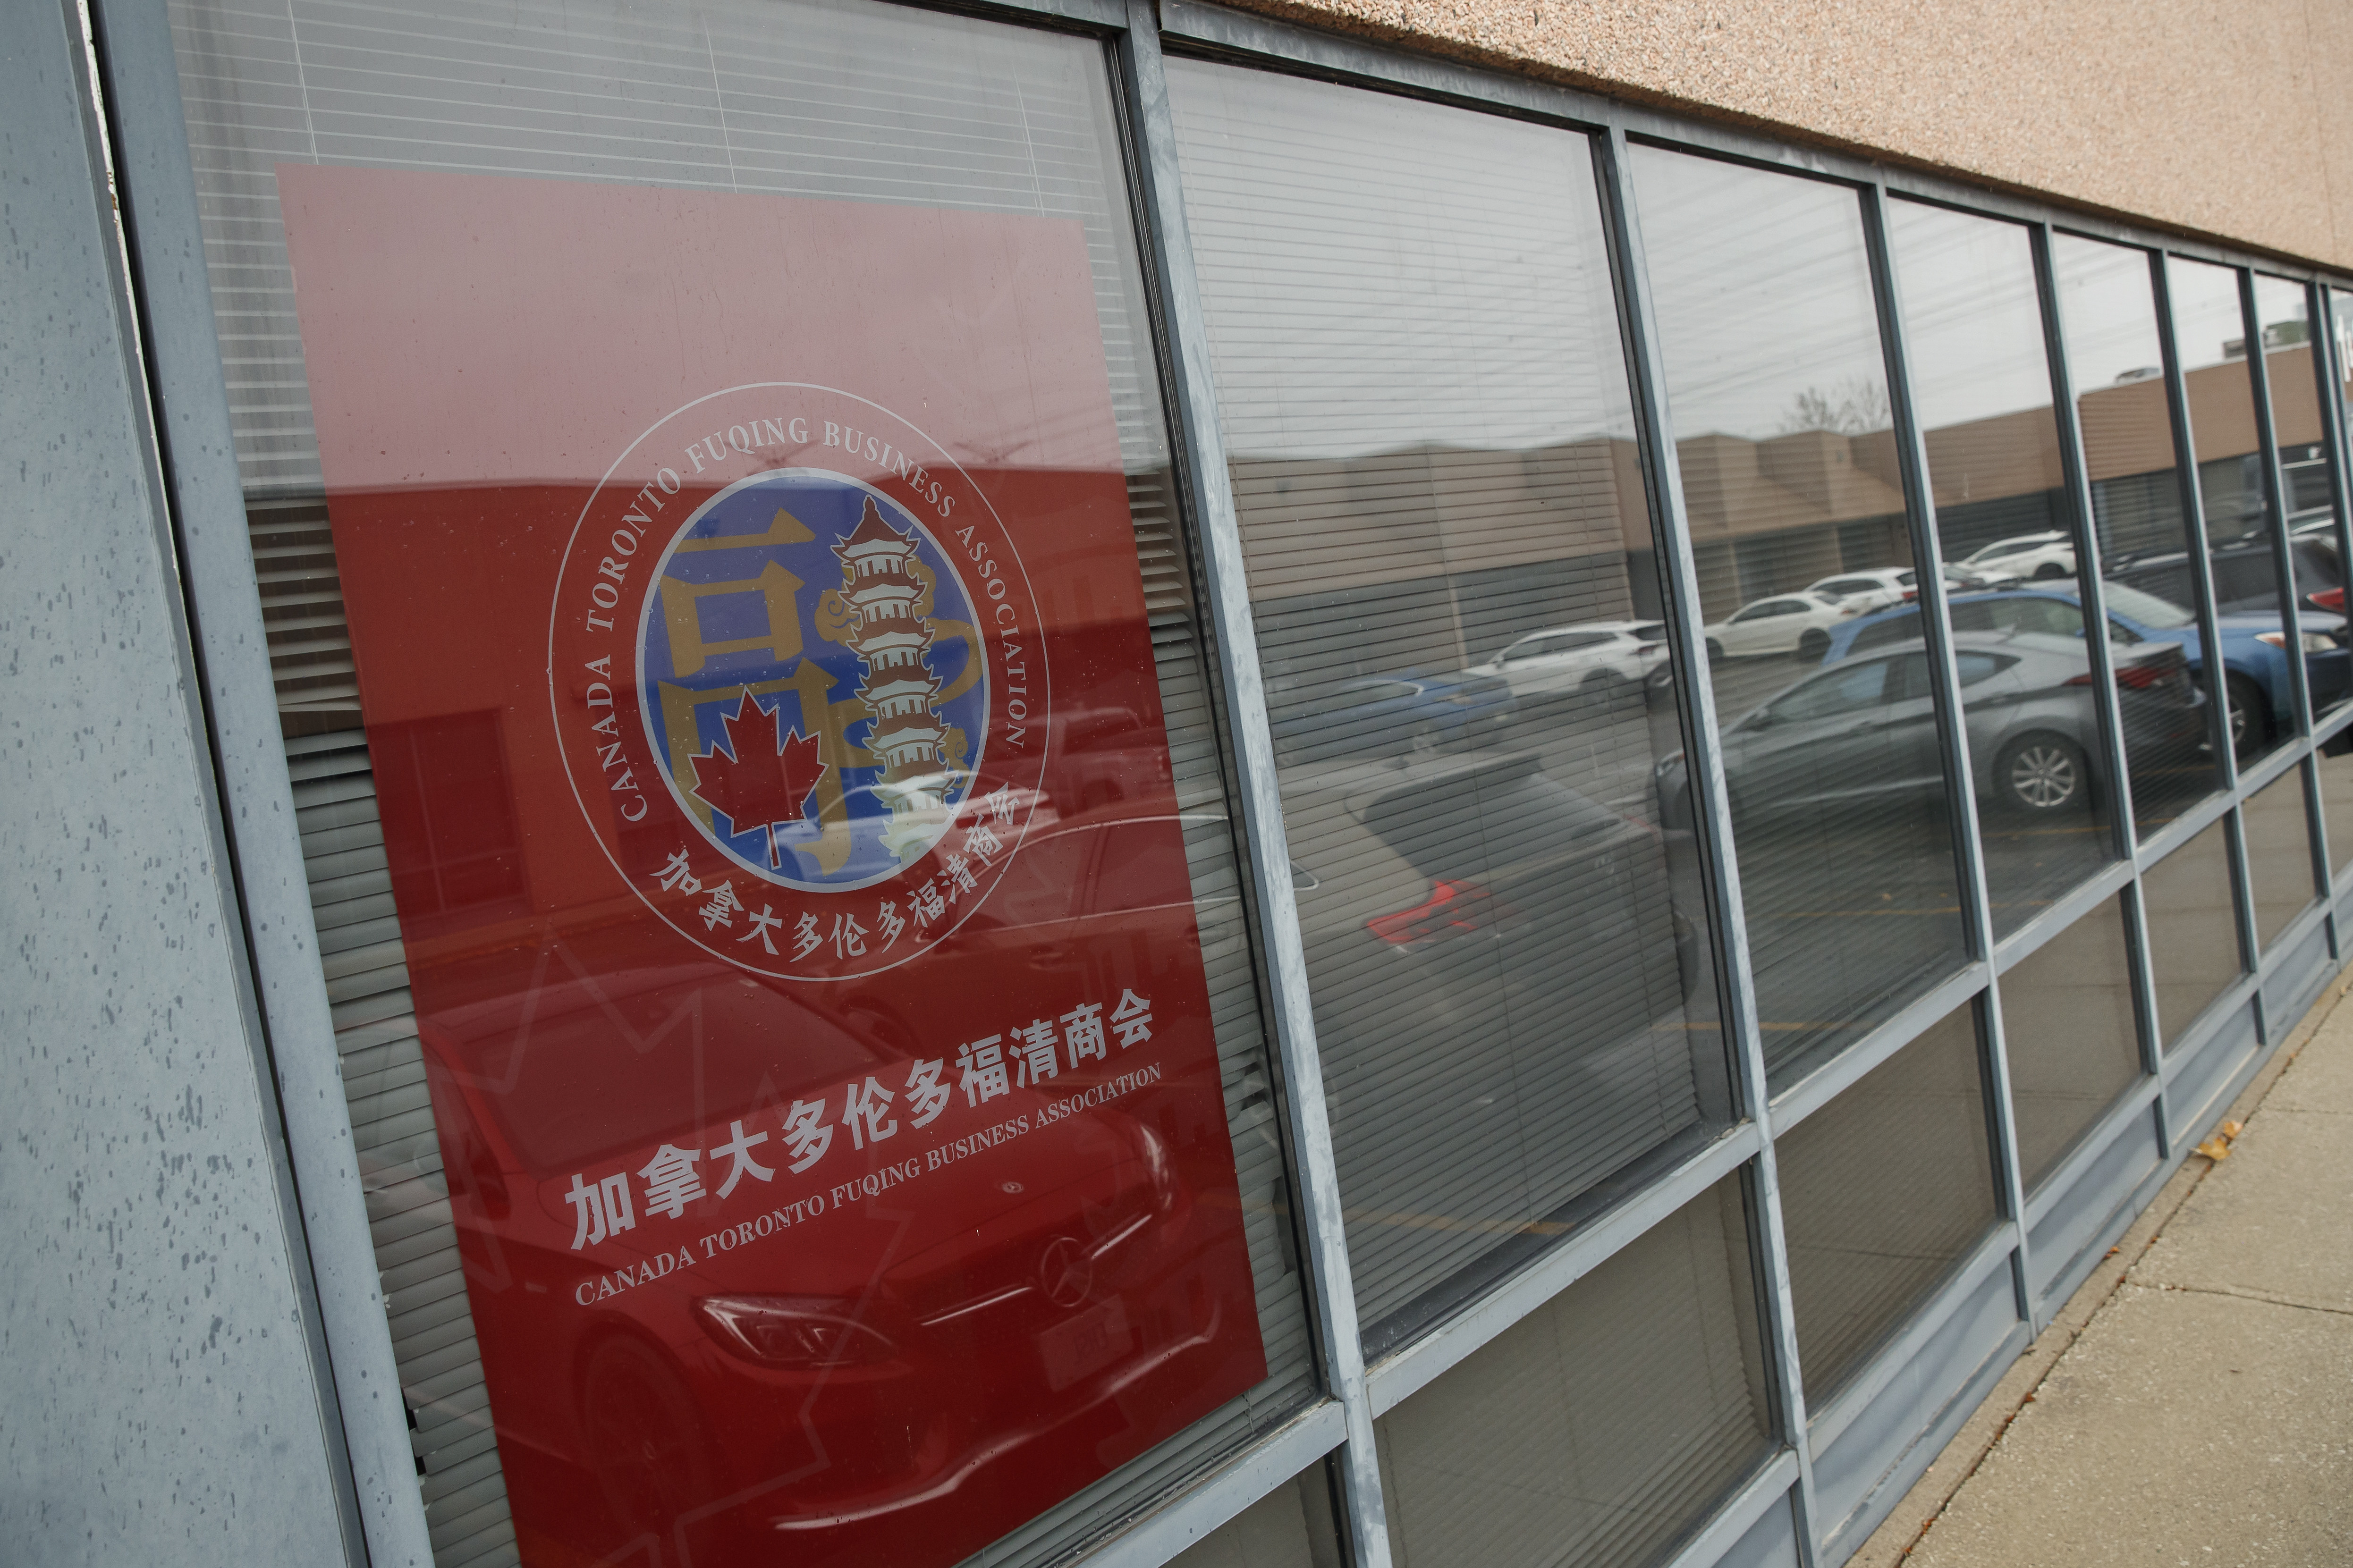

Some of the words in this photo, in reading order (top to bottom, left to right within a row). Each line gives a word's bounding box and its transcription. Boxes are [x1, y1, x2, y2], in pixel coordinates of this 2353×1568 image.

[684, 416, 809, 474] FUQING
[822, 421, 956, 518] BUSINESS
[585, 467, 682, 632] TORONTO
[955, 525, 1027, 748] ASSOCIATION
[585, 654, 647, 821] CANADA
[650, 782, 1020, 962] 加拿大多伦多福清商会
[565, 988, 1153, 1251] 加拿大多伦多福清商会
[575, 1244, 696, 1307] CANADA
[699, 1195, 826, 1259] TORONTO
[830, 1157, 922, 1209] FUQING
[924, 1114, 1030, 1170] BUSINESS
[1034, 1062, 1162, 1129] ASSOCIATION
